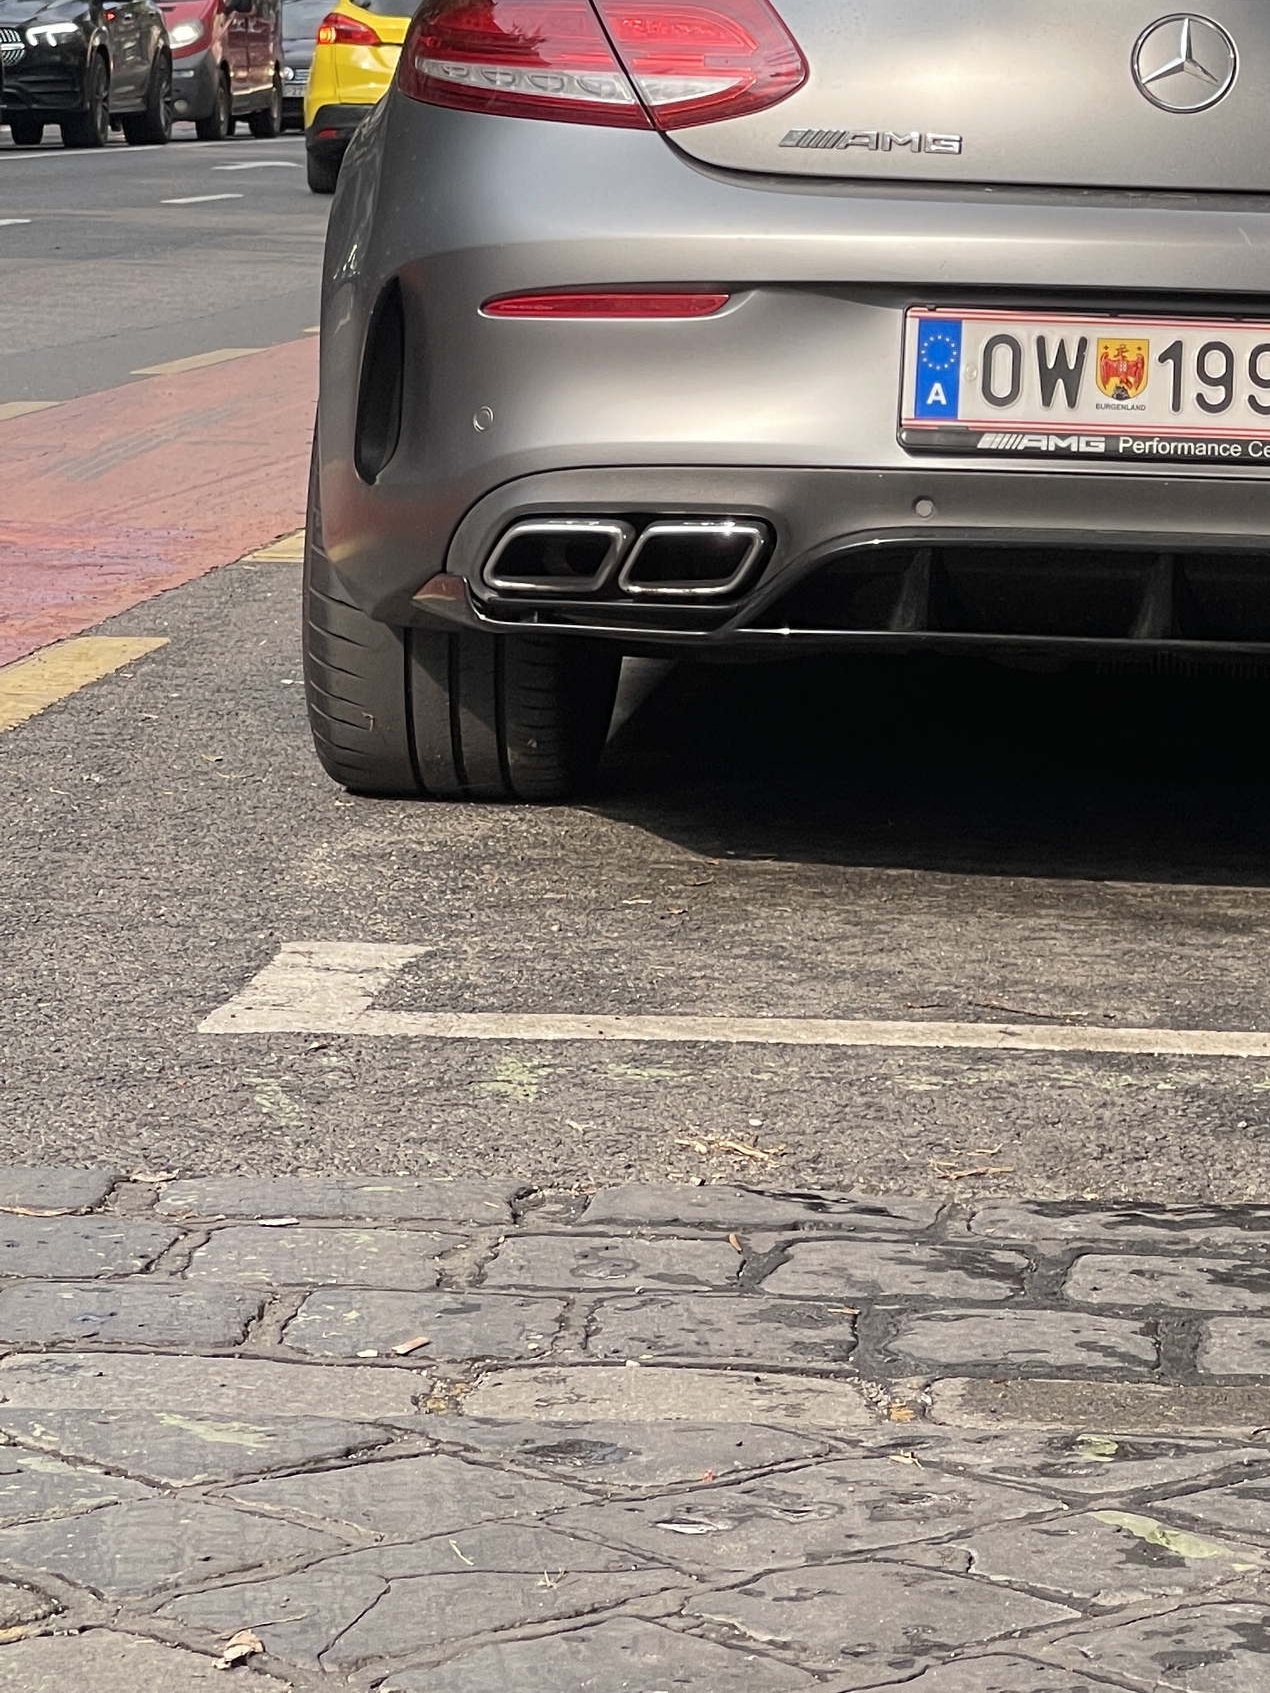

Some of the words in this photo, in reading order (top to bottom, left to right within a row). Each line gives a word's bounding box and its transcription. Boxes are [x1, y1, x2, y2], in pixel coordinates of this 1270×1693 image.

[926, 382, 947, 405] A
[1095, 403, 1147, 411] BURGENLAND
[1118, 436, 1243, 458] Performance
